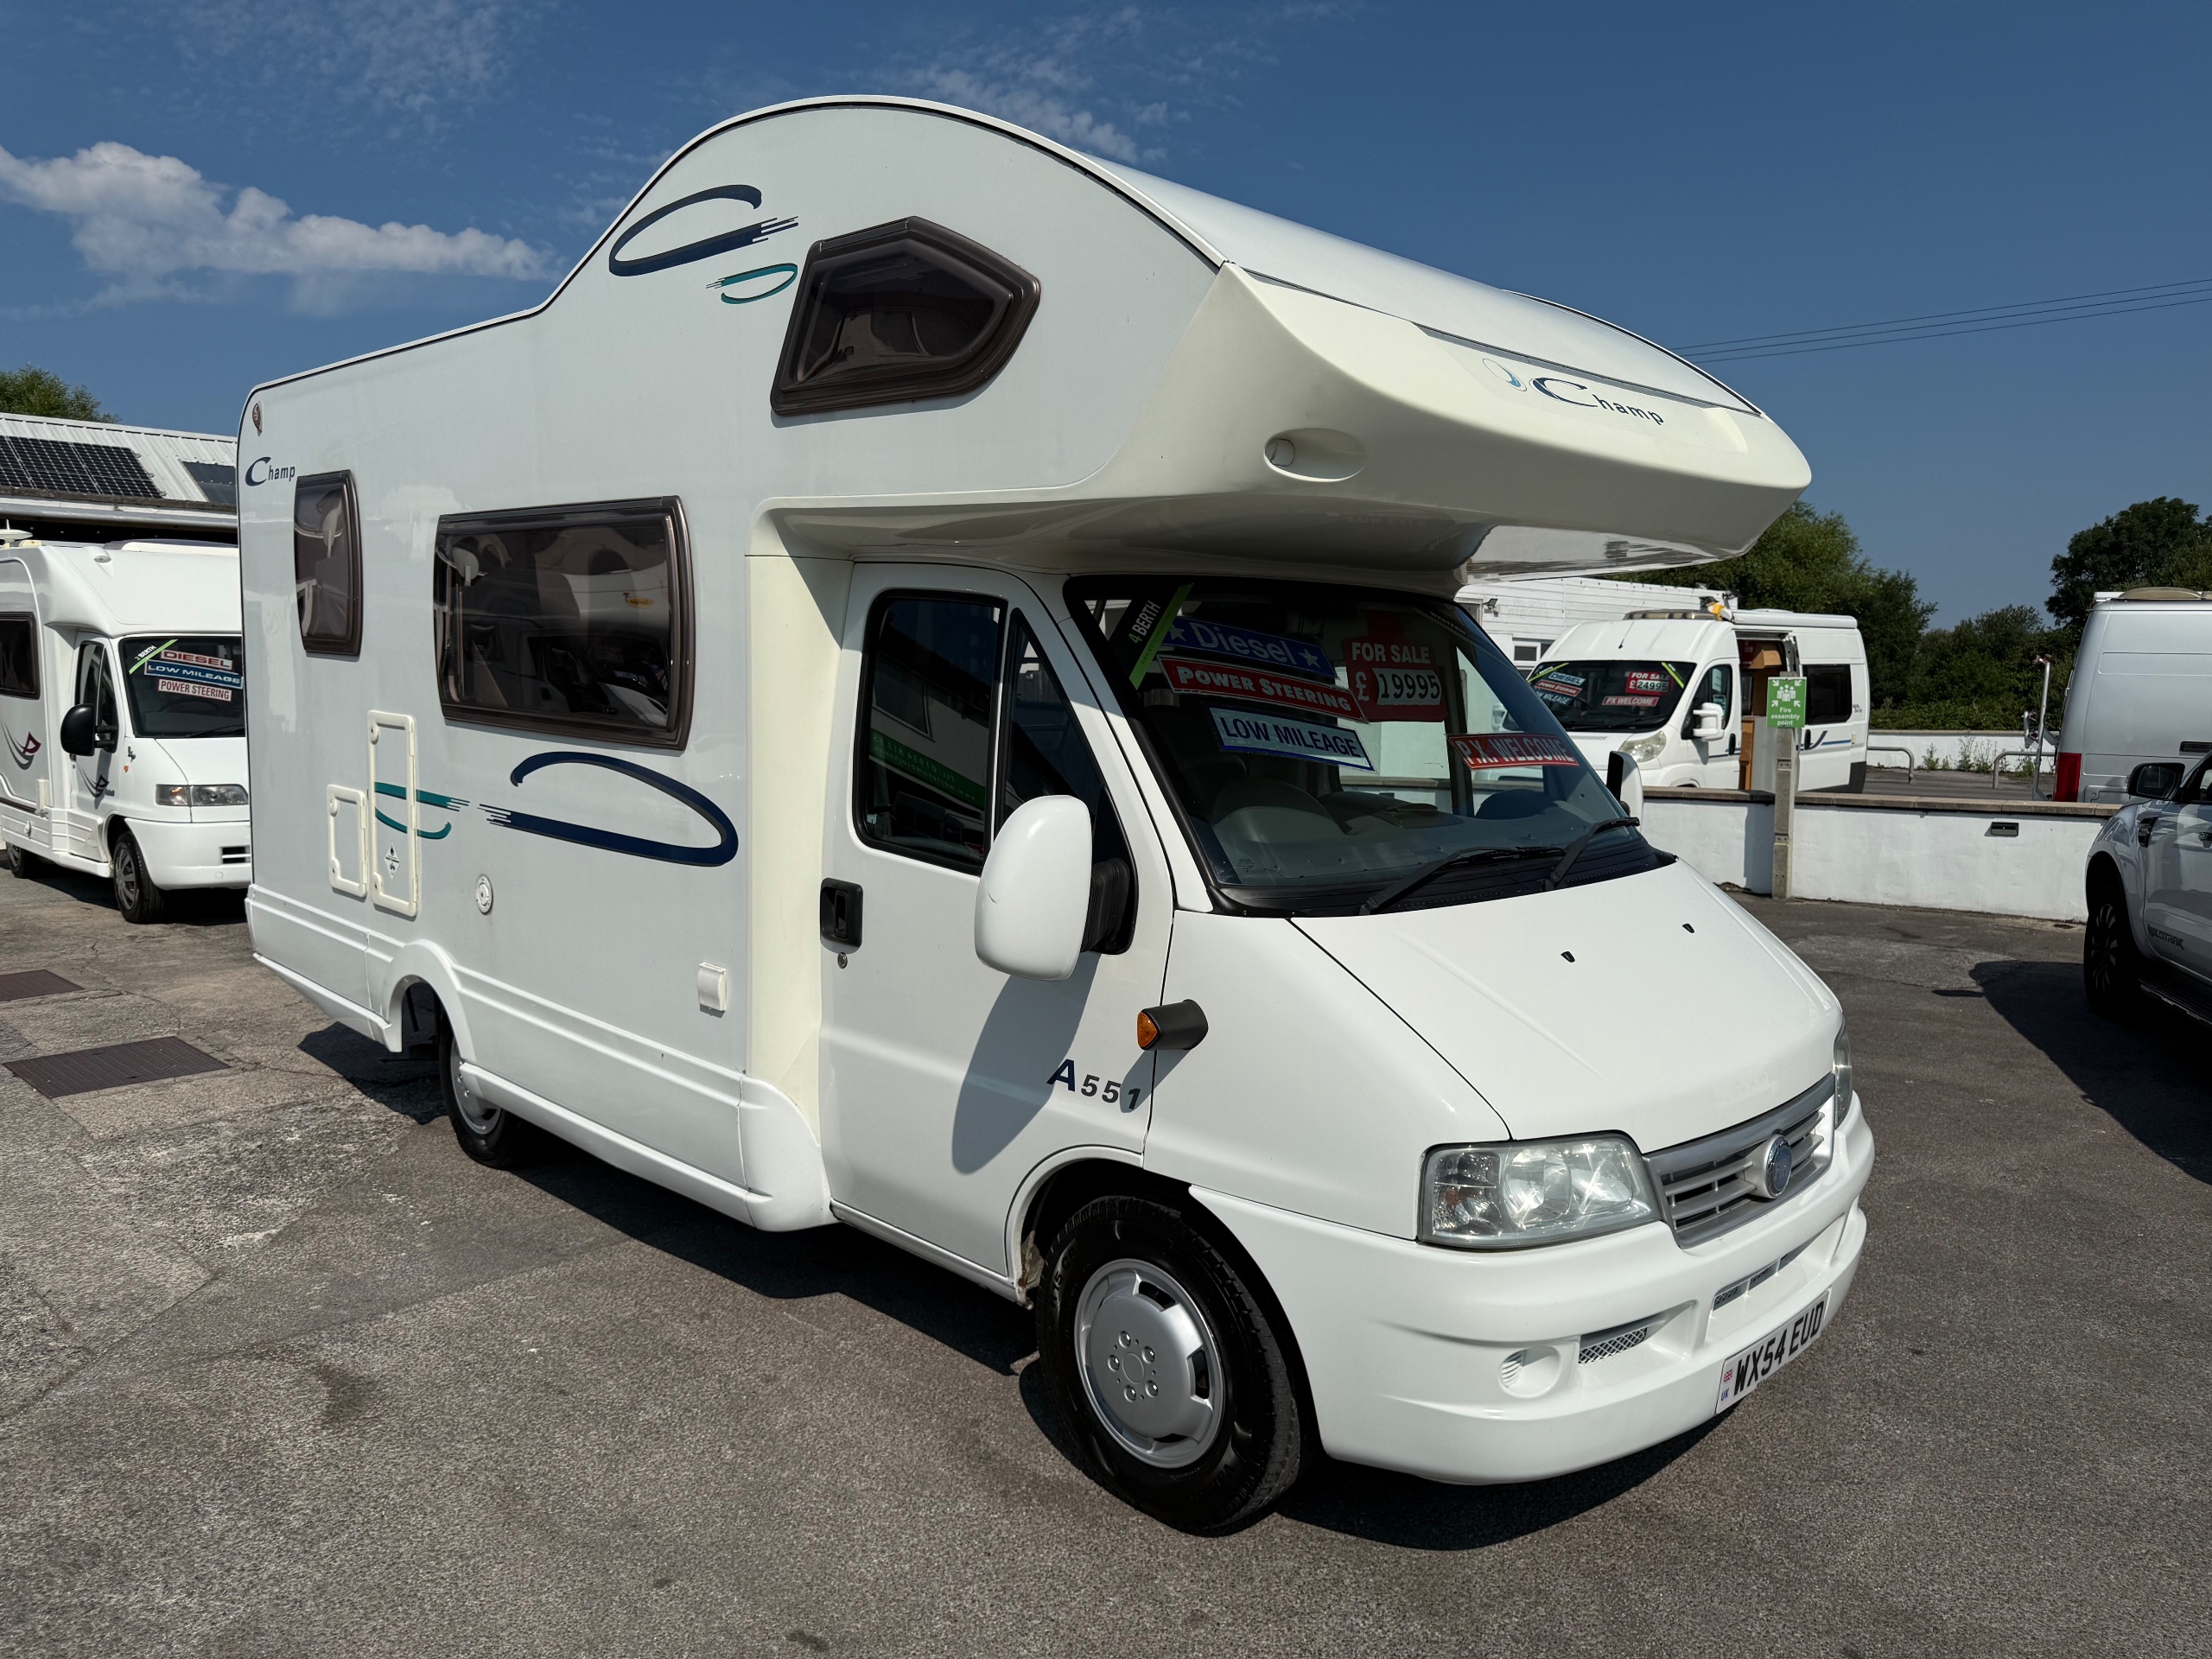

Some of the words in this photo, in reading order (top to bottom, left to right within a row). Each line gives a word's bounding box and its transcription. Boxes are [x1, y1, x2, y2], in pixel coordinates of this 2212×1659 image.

[1529, 377, 1664, 426] Champ
[245, 456, 296, 487] Champ
[1131, 600, 1161, 637] BERTH
[1128, 632, 1143, 644] 4
[1189, 621, 1298, 664] Diesel
[137, 645, 157, 658] BERTH
[164, 651, 231, 668] DIESEL
[1351, 641, 1387, 663] FOR
[1389, 644, 1431, 664] SALE
[148, 664, 181, 673] LOW
[181, 669, 241, 683] MILEAGE
[1550, 673, 1582, 684] DIESEL
[1649, 672, 1671, 681] SALE
[161, 680, 190, 694] POWER
[191, 685, 230, 700] STEERING
[1176, 665, 1256, 691] POWER
[1258, 677, 1352, 711] STEERING
[1355, 671, 1370, 702] £
[1378, 673, 1440, 700] 19995
[1637, 681, 1669, 690] 24995
[1617, 696, 1655, 706] WELCOME
[1219, 716, 1271, 741] LOW
[1272, 724, 1362, 758] MILEAGE
[1487, 737, 1574, 762] WELCOME
[1046, 1058, 1141, 1110] A551
[1732, 1329, 1788, 1397] WX54
[1788, 1300, 1826, 1357] EUD
[1721, 1388, 1730, 1402] UK
